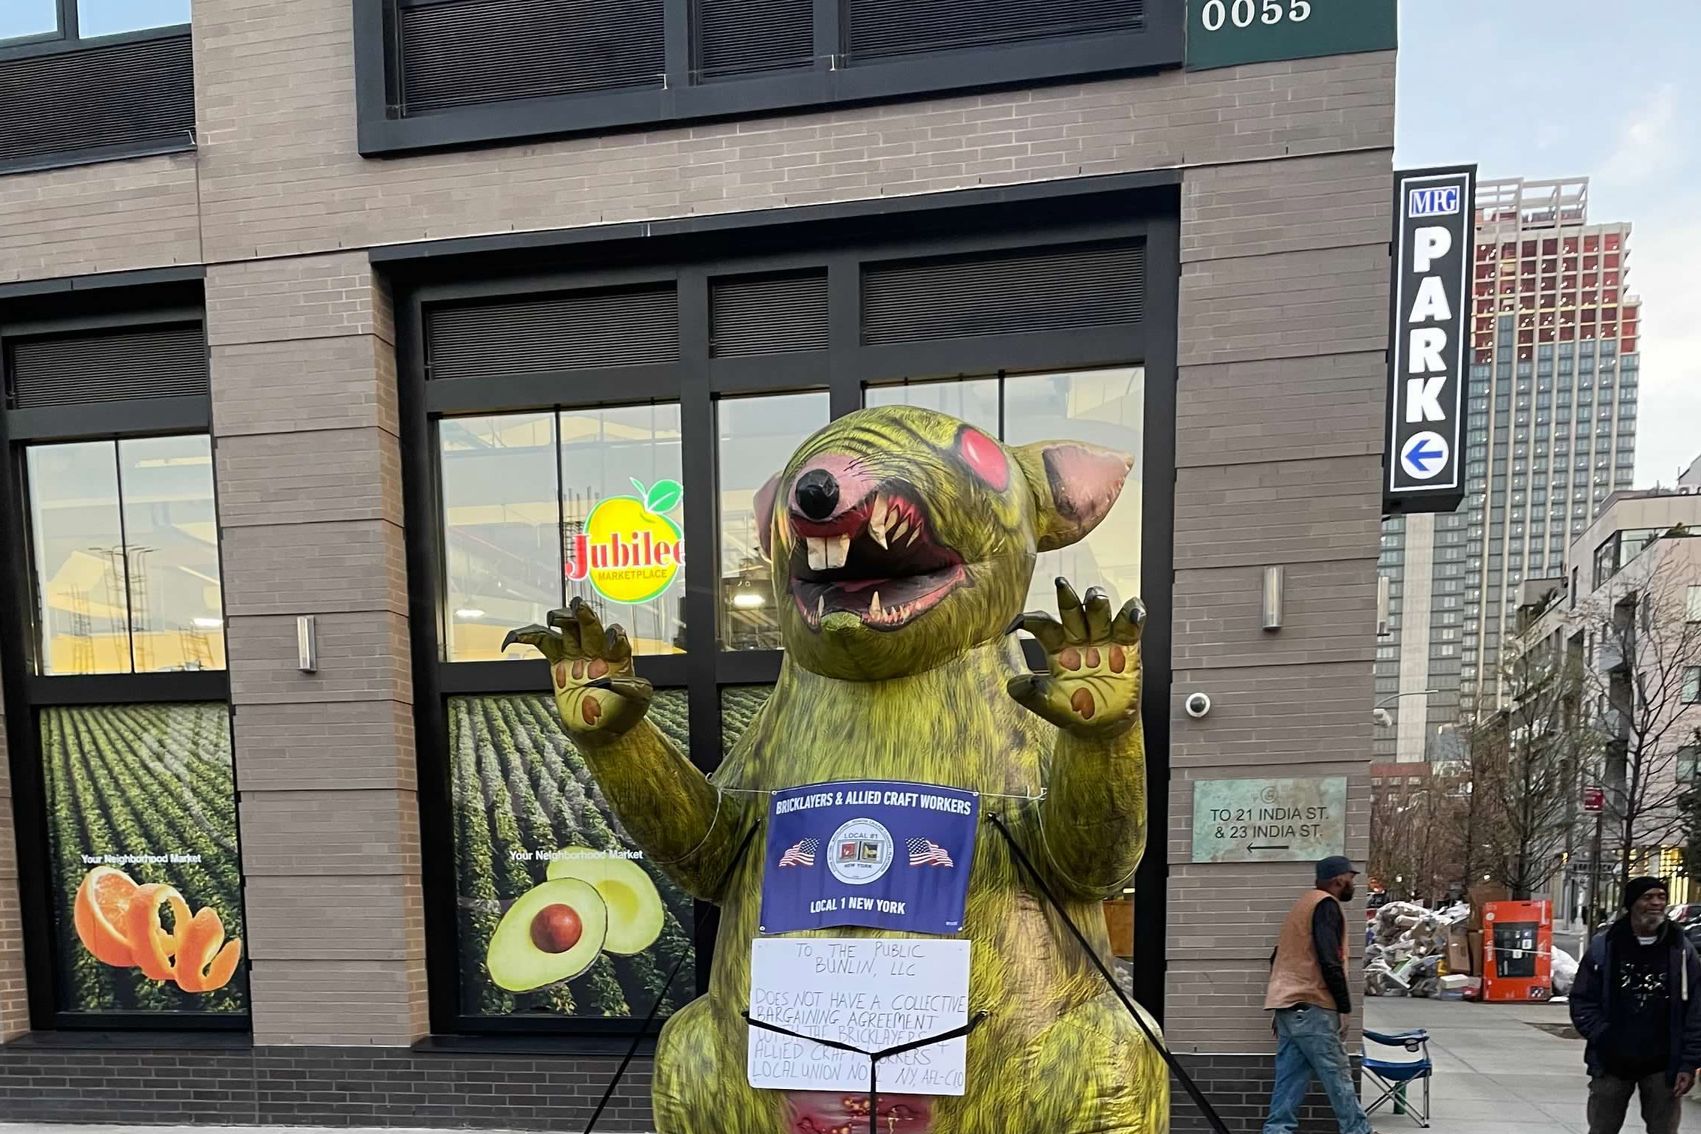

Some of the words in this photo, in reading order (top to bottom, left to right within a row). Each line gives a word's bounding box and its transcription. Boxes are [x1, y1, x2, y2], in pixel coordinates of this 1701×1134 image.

[1202, 0, 1311, 31] 0055
[1412, 189, 1457, 214] MPG
[1405, 226, 1452, 423] PARK
[565, 530, 685, 580] Jubilee
[598, 569, 668, 581] MARKETPLACE
[776, 792, 833, 815] BRICKLAYERS
[835, 791, 843, 805] &
[845, 790, 881, 805] ALLIED
[884, 791, 919, 808] CRAFT
[920, 794, 971, 815] WORKERS
[1210, 808, 1231, 822] TO
[1236, 809, 1252, 822] 21
[1259, 807, 1302, 821] INDIA
[1305, 806, 1329, 820] ST.
[1214, 826, 1225, 839] &
[1230, 825, 1247, 839] 23
[1253, 824, 1296, 838] INDIA
[1300, 824, 1323, 838] ST.
[80, 854, 102, 864] Your
[104, 854, 168, 866] Neighborhood
[170, 854, 202, 863] Market
[509, 851, 533, 861] Your
[535, 850, 607, 861] Neighborhood
[609, 849, 643, 860] Market
[810, 898, 837, 914] LOCAL
[841, 897, 846, 909] 1
[849, 896, 873, 911] NEW
[876, 899, 906, 915] YORK
[796, 942, 812, 957] TO
[828, 943, 855, 958] THE
[875, 941, 926, 958] PUBLIC
[891, 962, 916, 977] LLC
[756, 988, 789, 1006] DOES
[793, 990, 823, 1007] NOT
[830, 992, 866, 1009] HAVE
[870, 994, 880, 1010] A
[891, 994, 966, 1013] COLLECTIVE
[757, 1006, 840, 1024] BARGAINING
[847, 1011, 939, 1030] AGREEMENT
[755, 1040, 804, 1060] ALLIED
[867, 1045, 931, 1065] ORKERS
[753, 1061, 800, 1078] LOCAL
[801, 1063, 841, 1080] UNION
